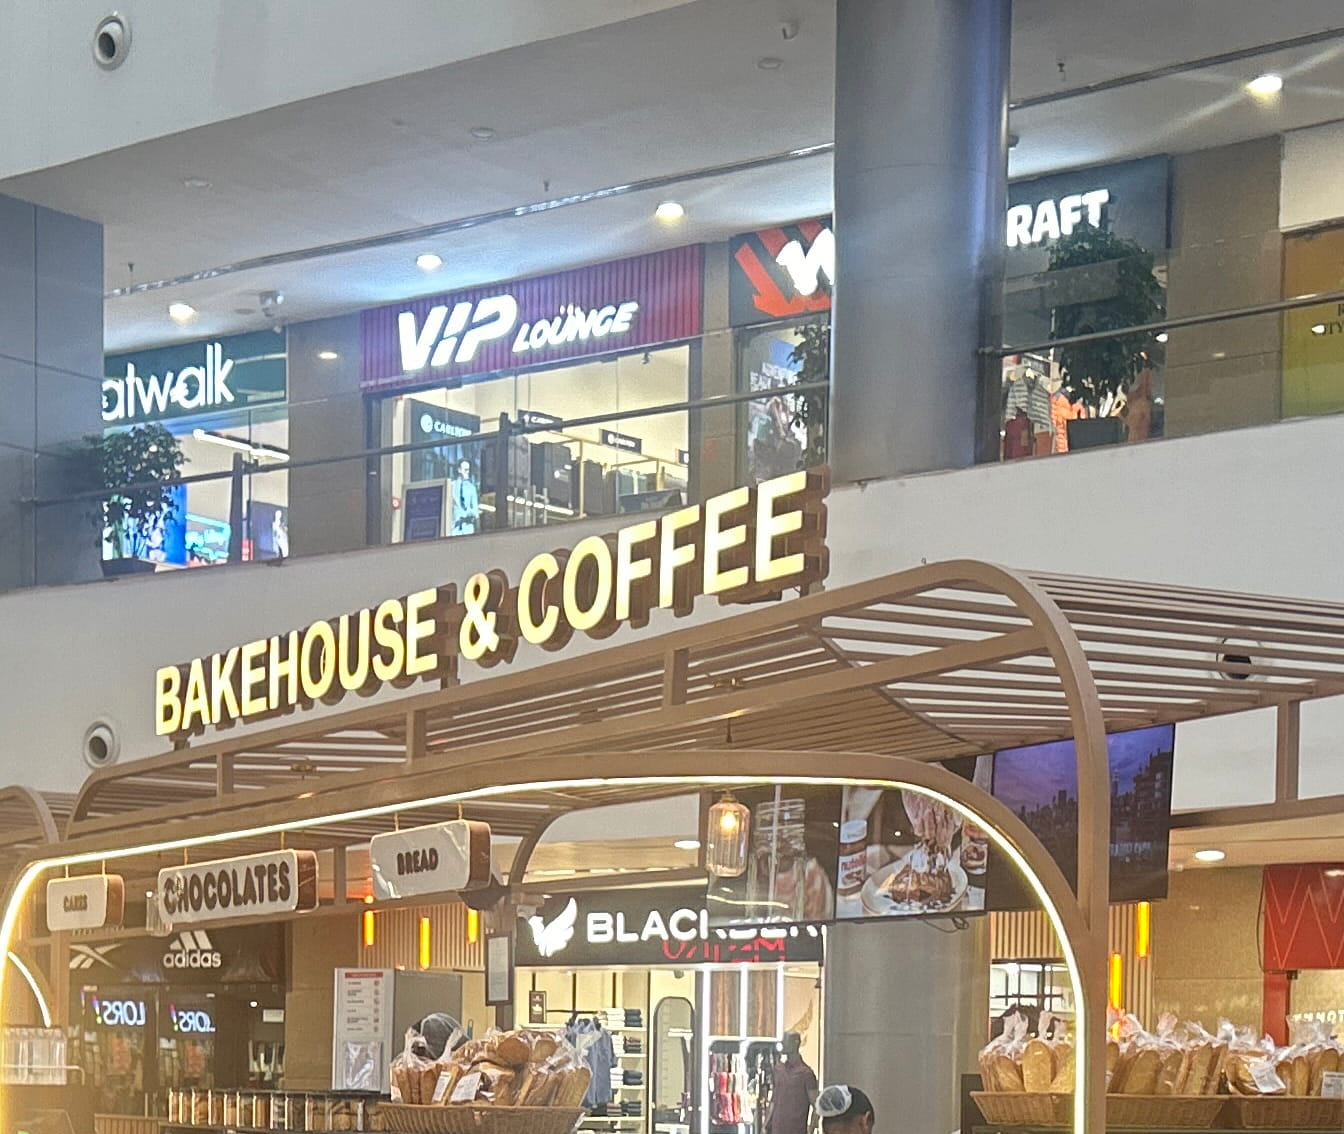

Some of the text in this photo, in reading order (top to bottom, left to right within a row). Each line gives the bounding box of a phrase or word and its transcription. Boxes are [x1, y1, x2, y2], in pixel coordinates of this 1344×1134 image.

[398, 294, 518, 371] VIP
[155, 470, 808, 736] BAKEHOUSE & COFFEE
[163, 860, 291, 915] CHOCOLATES
[397, 847, 439, 876] BREAD
[163, 950, 222, 968] adidas
